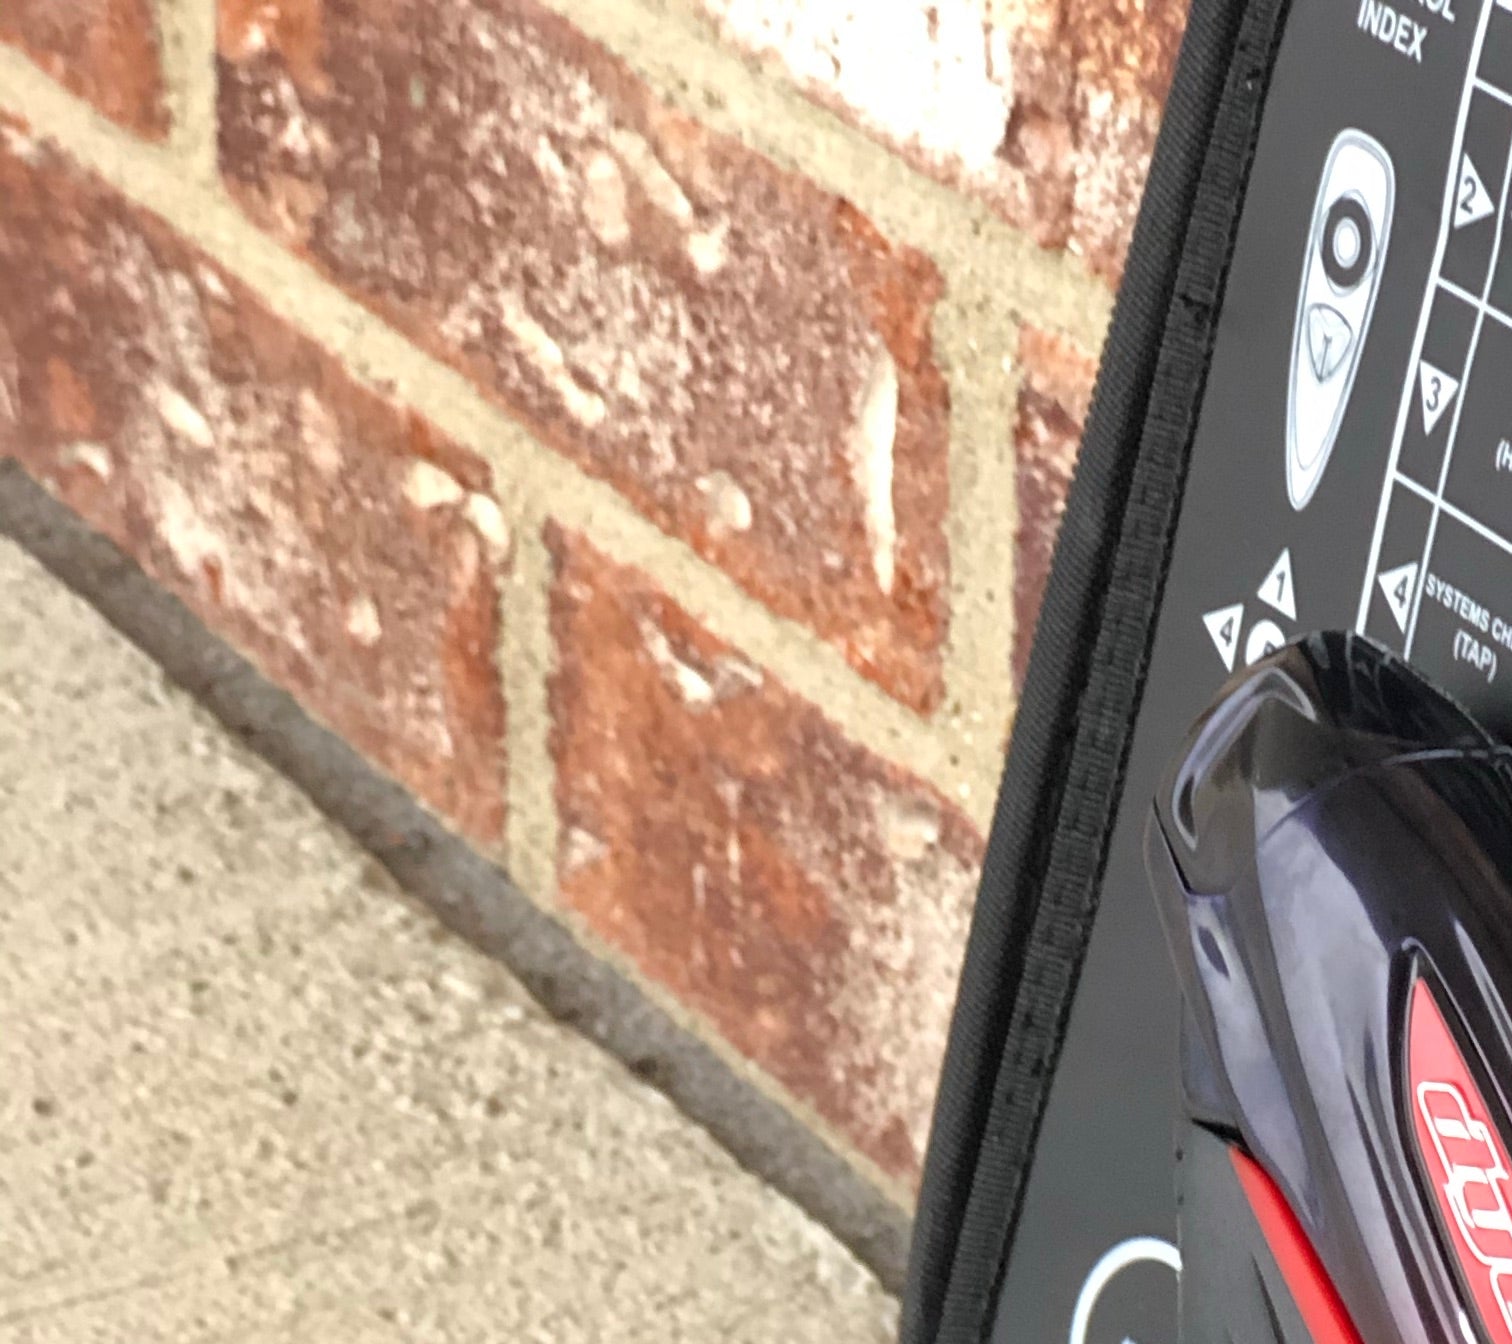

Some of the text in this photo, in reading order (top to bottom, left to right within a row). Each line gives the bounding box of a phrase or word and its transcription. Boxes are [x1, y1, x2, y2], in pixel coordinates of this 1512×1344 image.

[1356, 0, 1427, 62] INDEX
[1460, 177, 1478, 214] 2
[1425, 378, 1442, 412] 3
[1276, 570, 1286, 603] 1
[1393, 574, 1409, 609] 4
[1425, 572, 1490, 632] SYSTEMS
[1453, 630, 1497, 682] (TAP)
